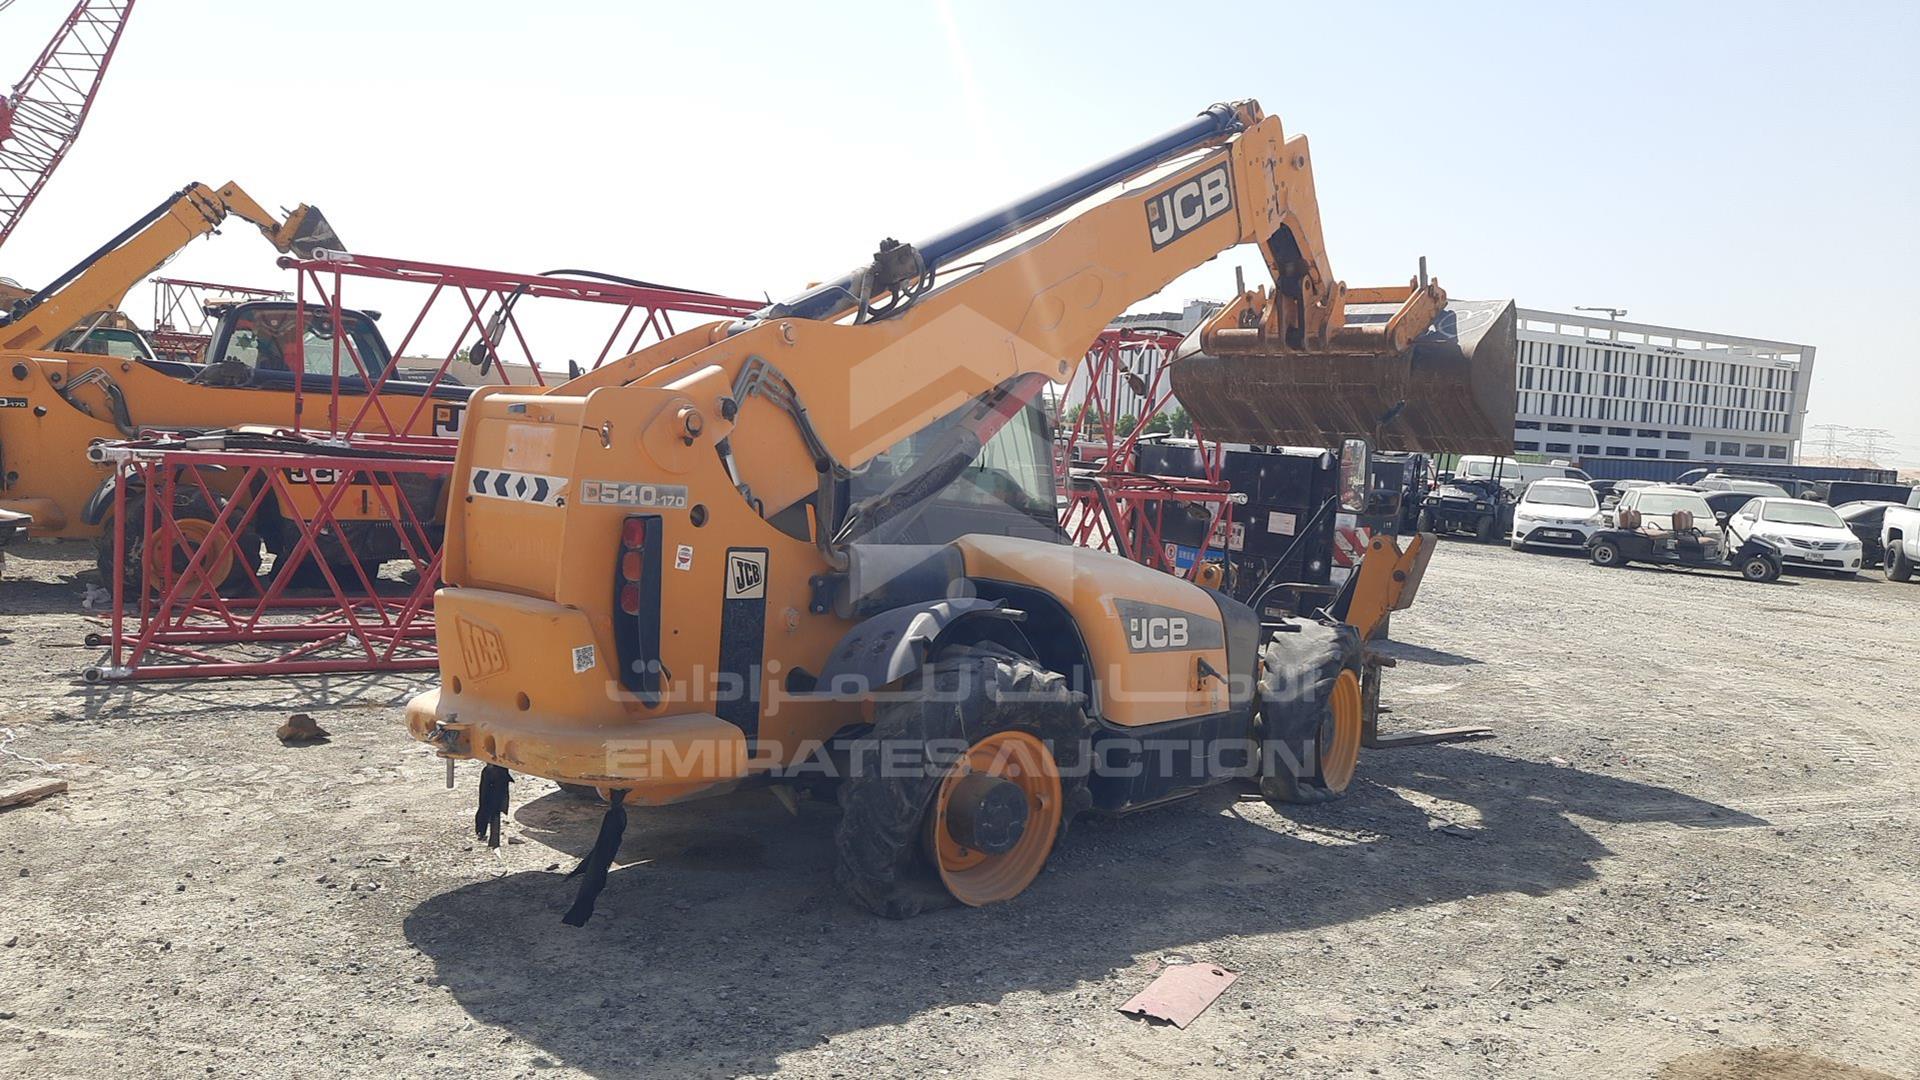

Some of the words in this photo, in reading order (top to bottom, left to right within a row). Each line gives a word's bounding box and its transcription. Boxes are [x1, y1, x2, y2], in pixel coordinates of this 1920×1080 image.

[1151, 168, 1230, 245] JCB
[735, 560, 761, 590] JCB
[460, 620, 502, 678] JCB
[1130, 617, 1189, 649] JCB
